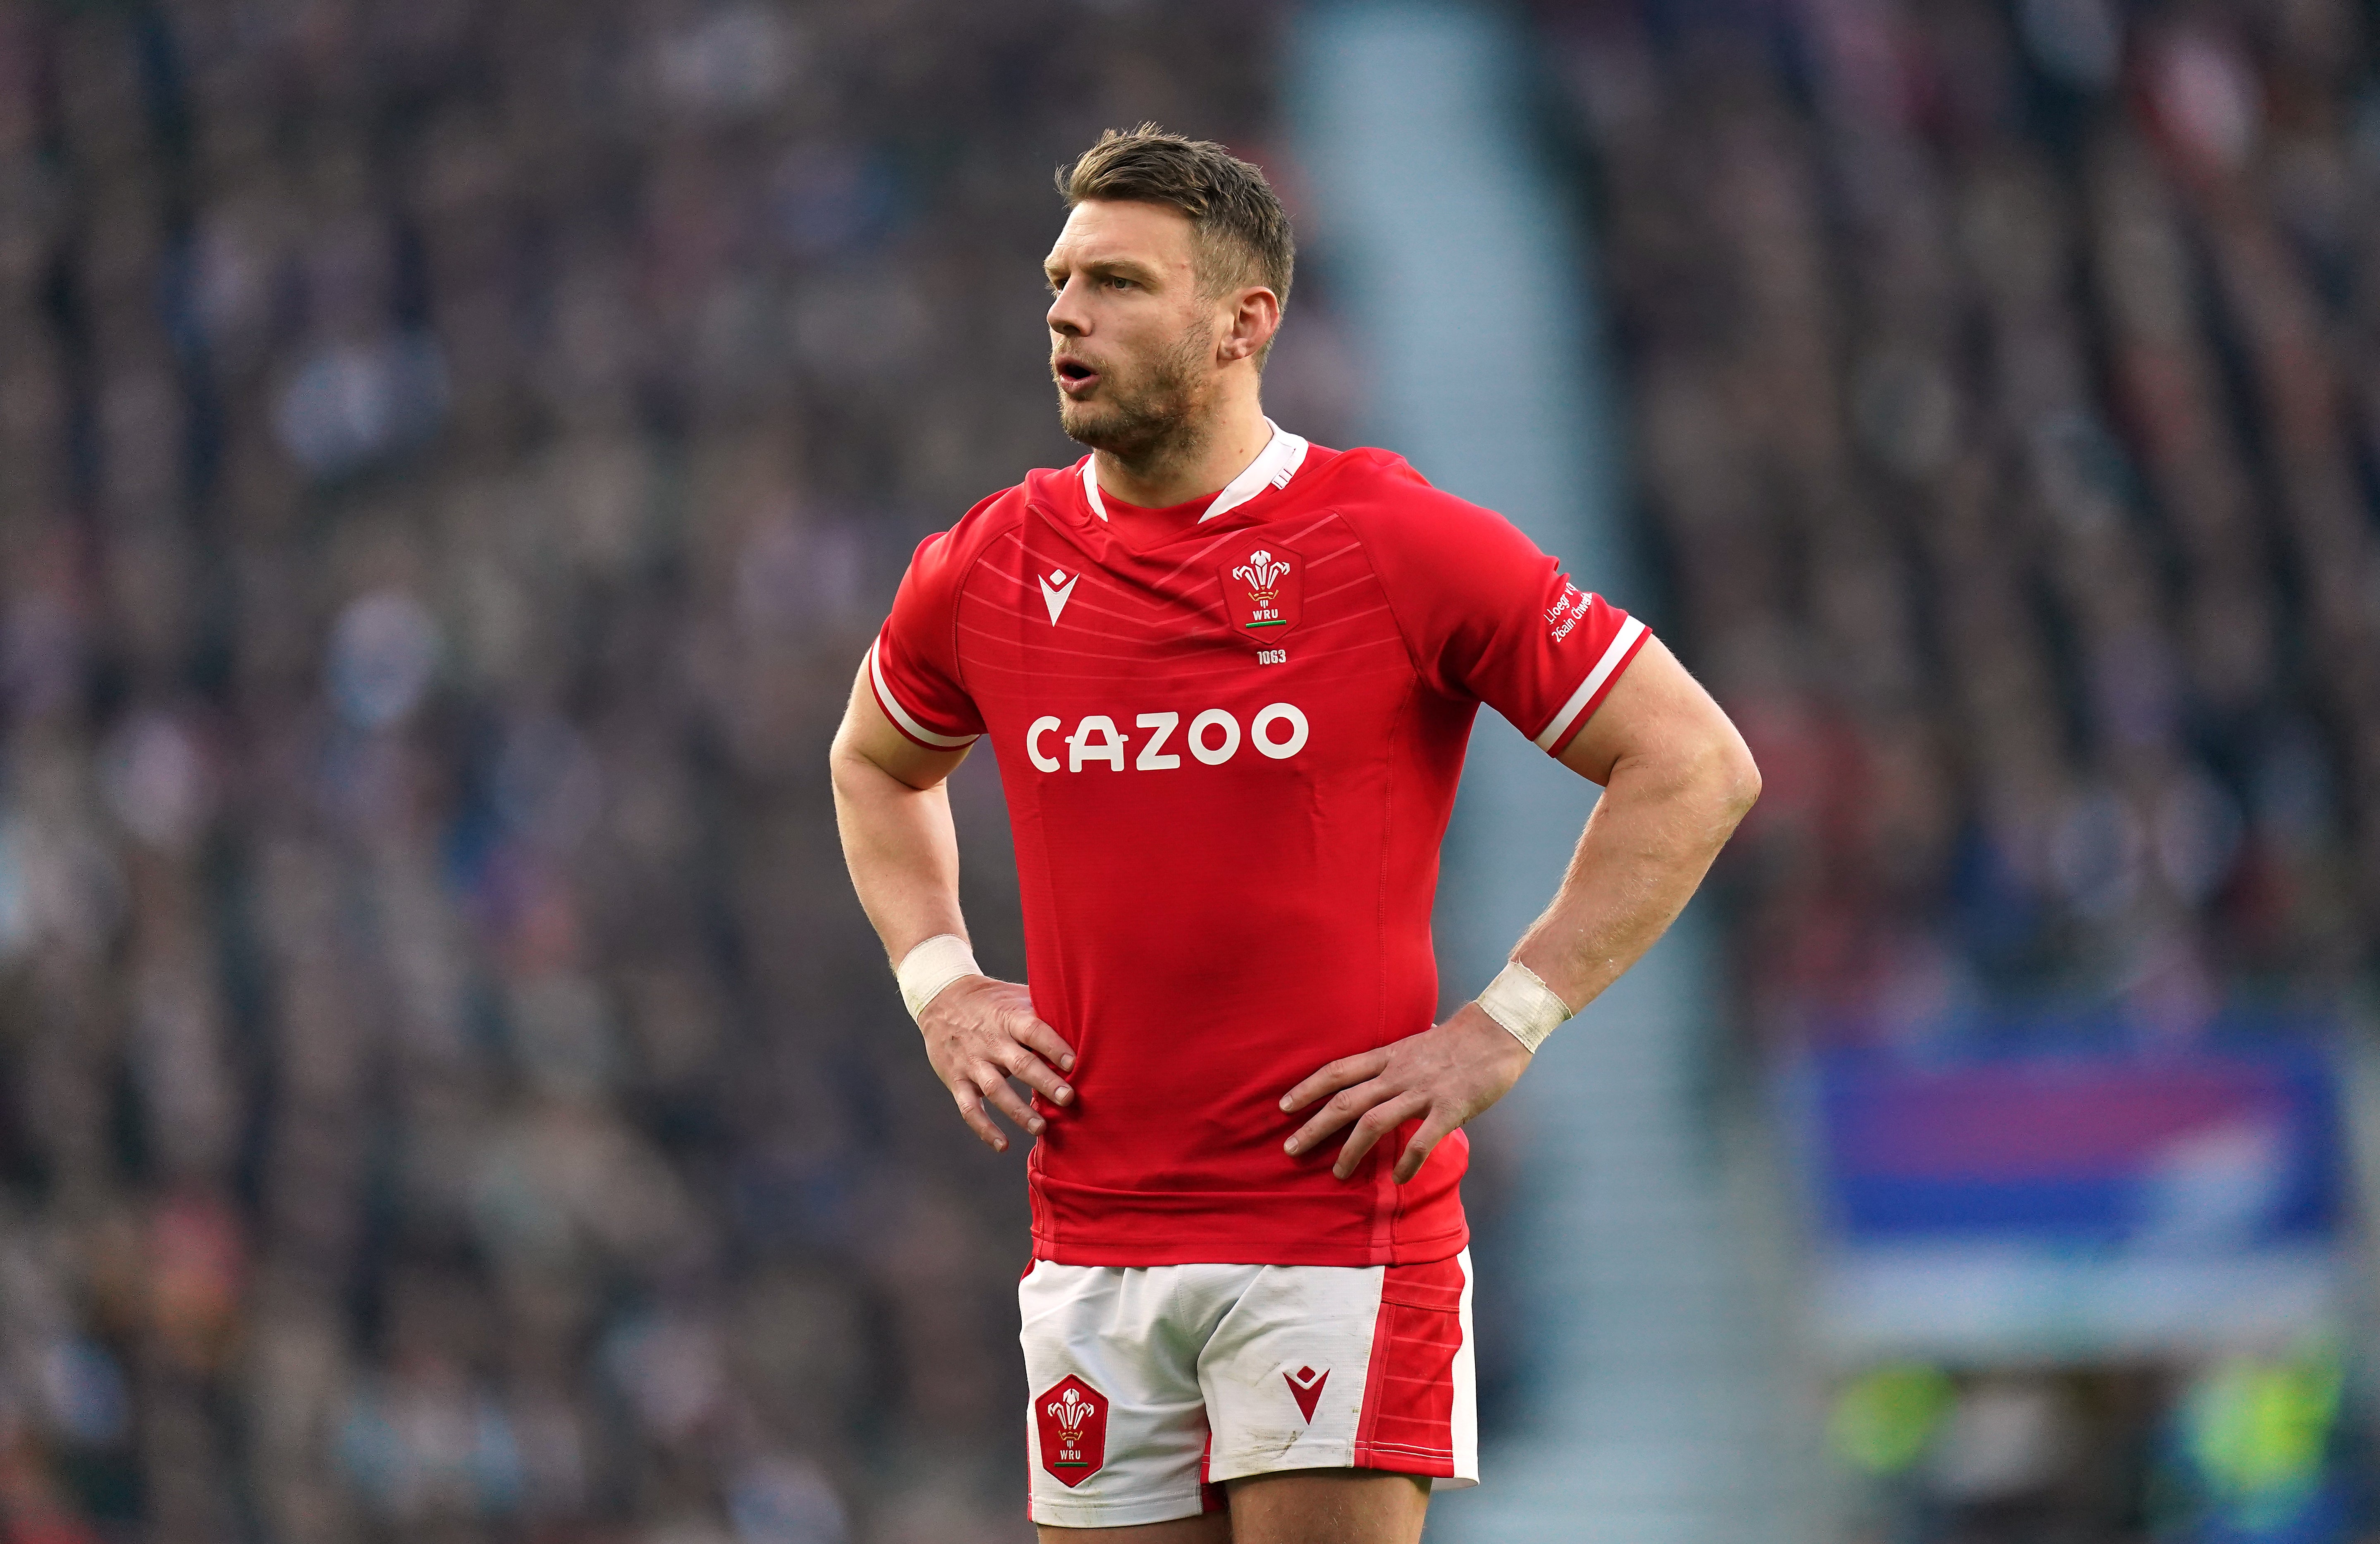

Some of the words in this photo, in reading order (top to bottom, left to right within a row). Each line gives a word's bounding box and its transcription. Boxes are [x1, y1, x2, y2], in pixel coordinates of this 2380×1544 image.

[1252, 609, 1278, 621] WRU
[1543, 594, 1570, 623] Lloegr
[1565, 587, 1574, 596] v
[1551, 618, 1576, 643] 26ain
[1257, 649, 1286, 665] 1063
[1026, 702, 1309, 773] CAZOO
[1060, 1450, 1080, 1460] WRU
